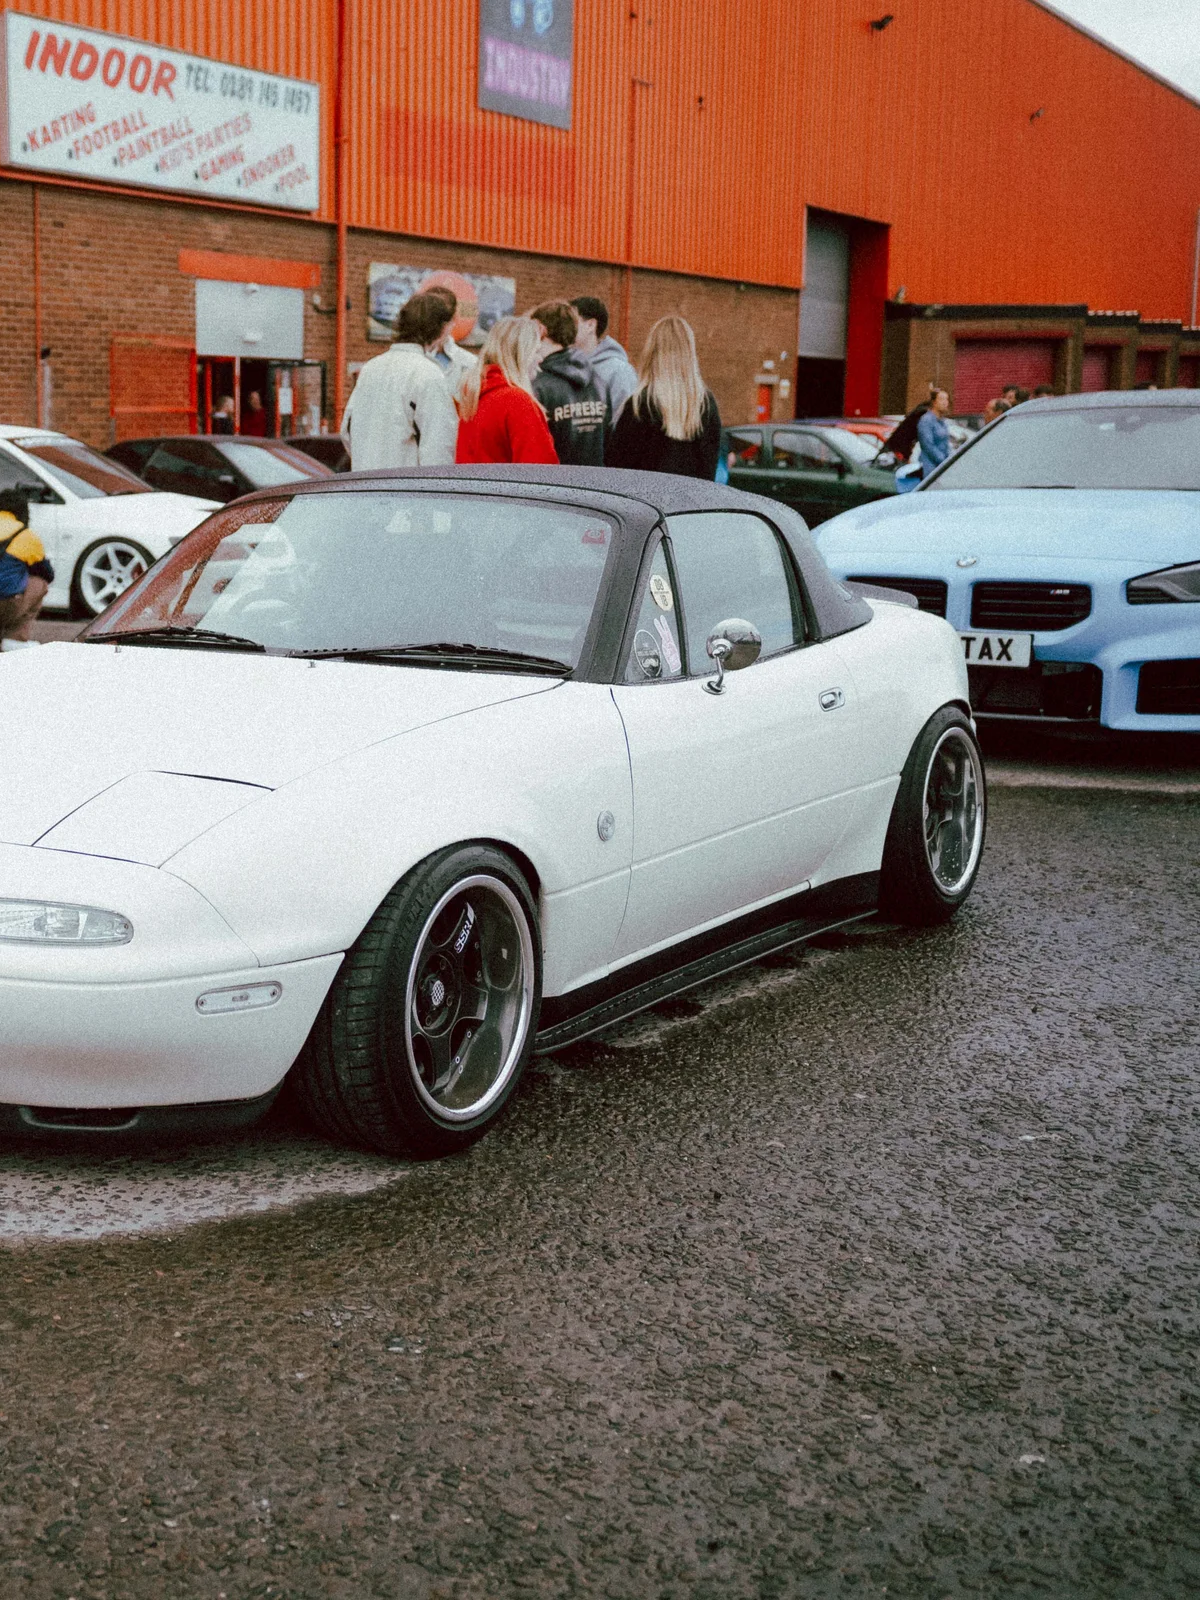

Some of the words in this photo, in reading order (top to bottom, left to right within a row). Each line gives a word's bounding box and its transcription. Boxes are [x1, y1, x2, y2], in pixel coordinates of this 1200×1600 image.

[25, 30, 177, 101] INDOOR
[27, 101, 96, 152] KARTING
[73, 108, 148, 160] FOOTBALL
[119, 115, 194, 167] PAINTBALL
[960, 636, 1014, 661] TAX
